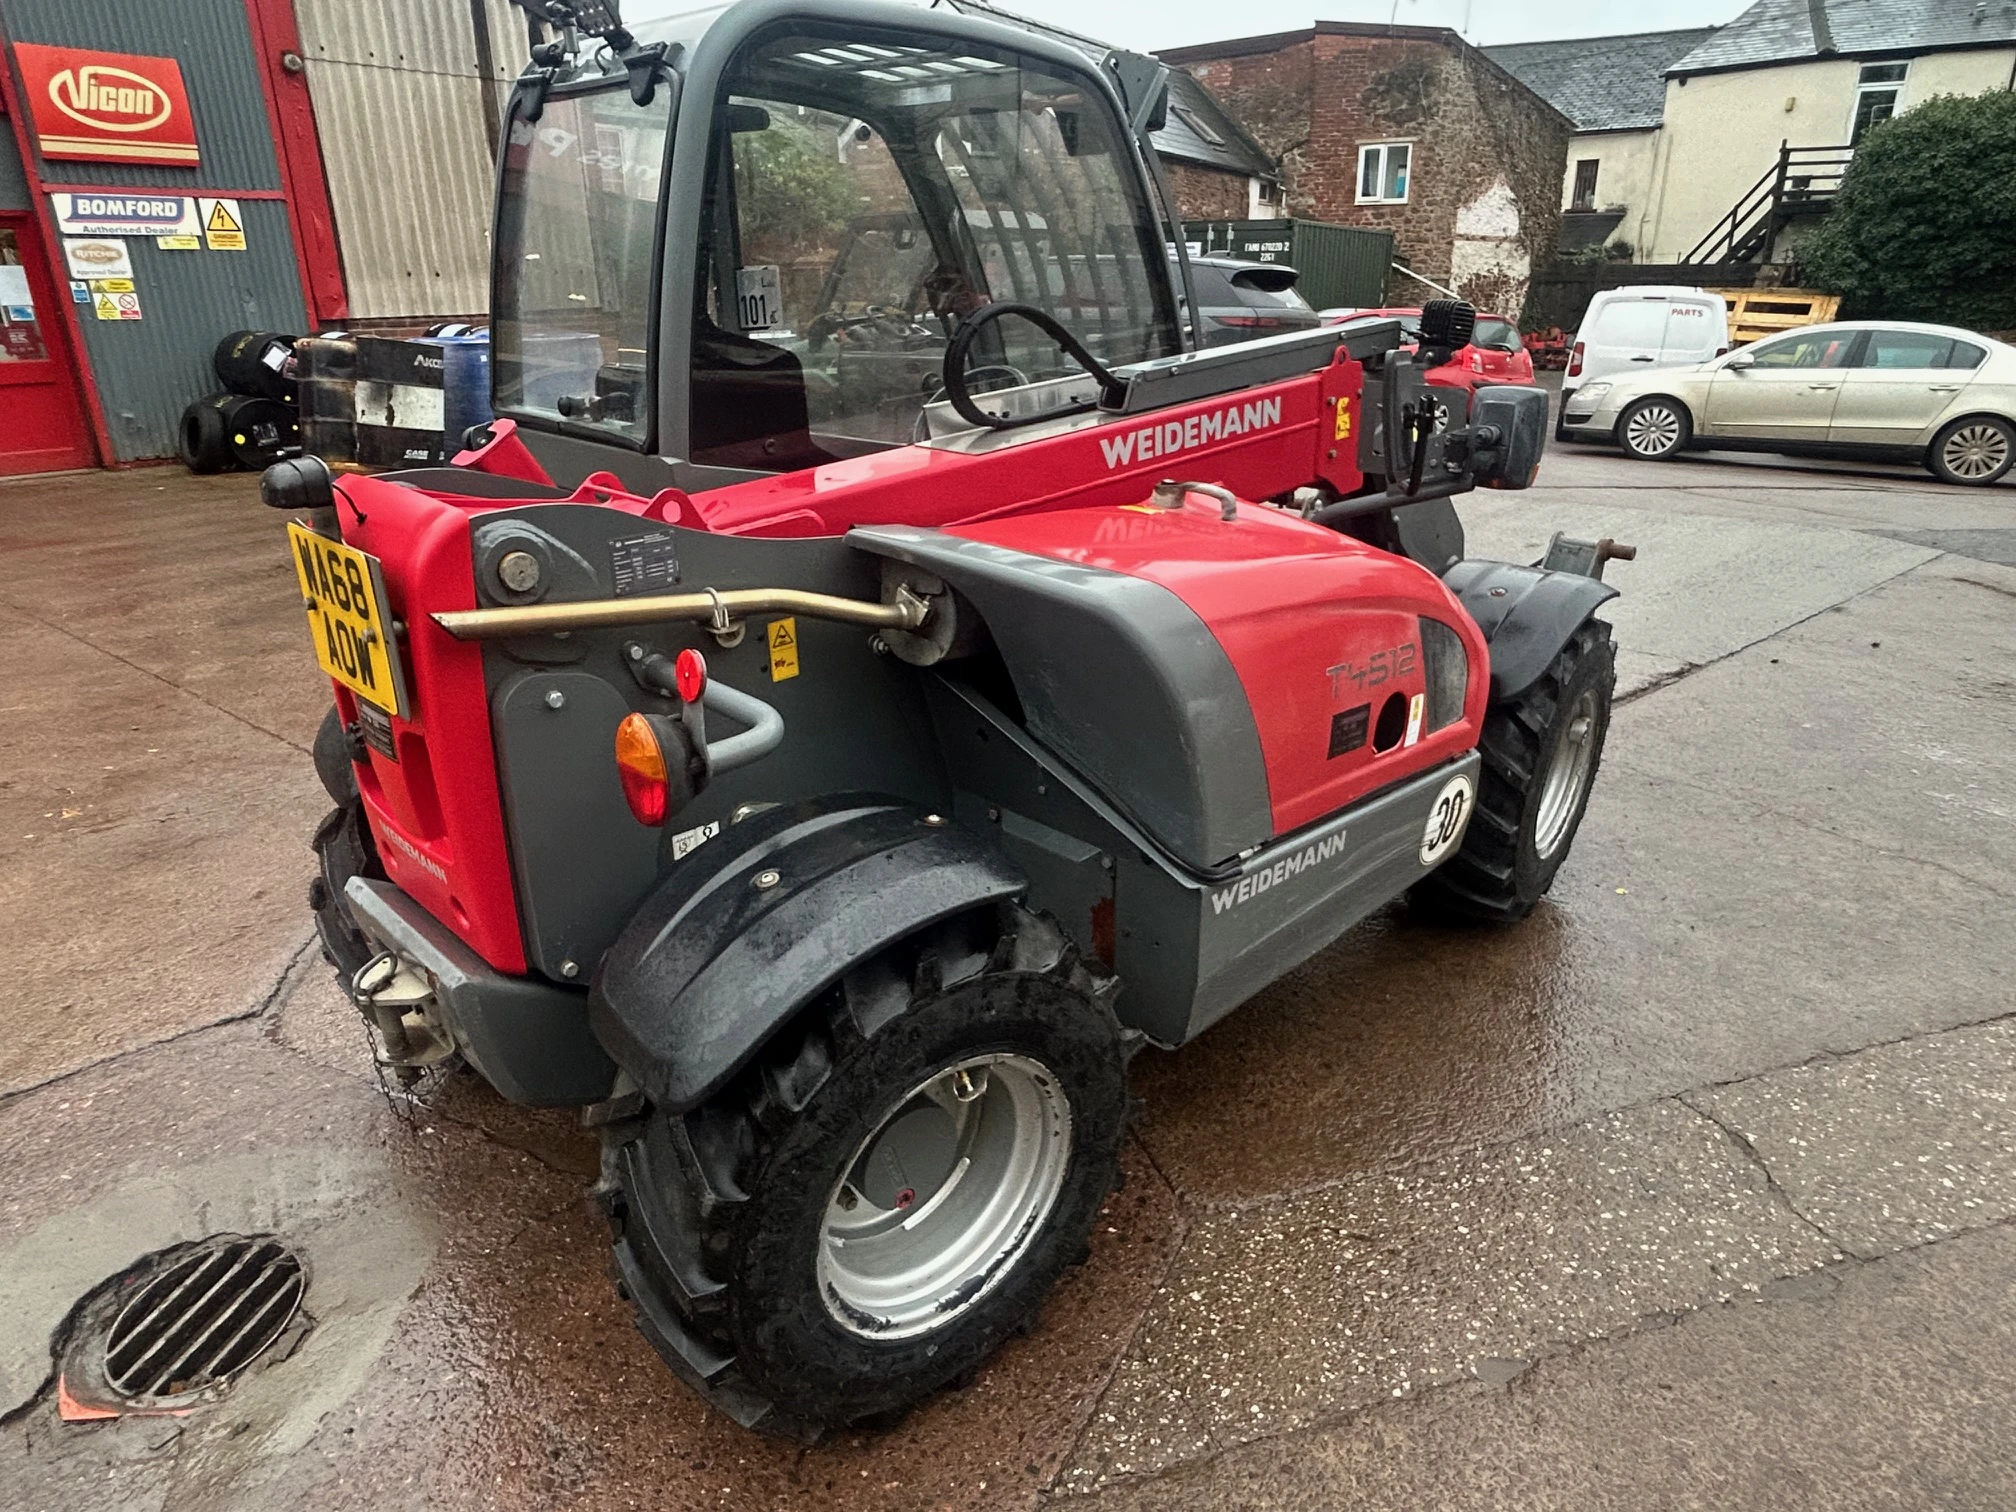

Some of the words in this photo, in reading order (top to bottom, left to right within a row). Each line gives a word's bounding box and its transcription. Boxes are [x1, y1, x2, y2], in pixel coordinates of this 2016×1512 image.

[66, 66, 154, 115] Vicon
[77, 199, 178, 217] BOMFORD
[82, 225, 142, 234] Authorised
[144, 226, 179, 235] Dealer
[75, 249, 120, 259] RITCHIE
[1284, 241, 1290, 252] 2
[740, 294, 767, 326] 101
[1671, 308, 1704, 318] PARTS
[1099, 396, 1282, 470] WEIDEMANN
[296, 532, 370, 621] WA68
[322, 610, 376, 691] AOW
[1325, 642, 1415, 701] T4512
[1427, 788, 1465, 852] 30
[379, 818, 448, 885] WEIDEMANN
[1211, 830, 1347, 915] WEIDEMANN
